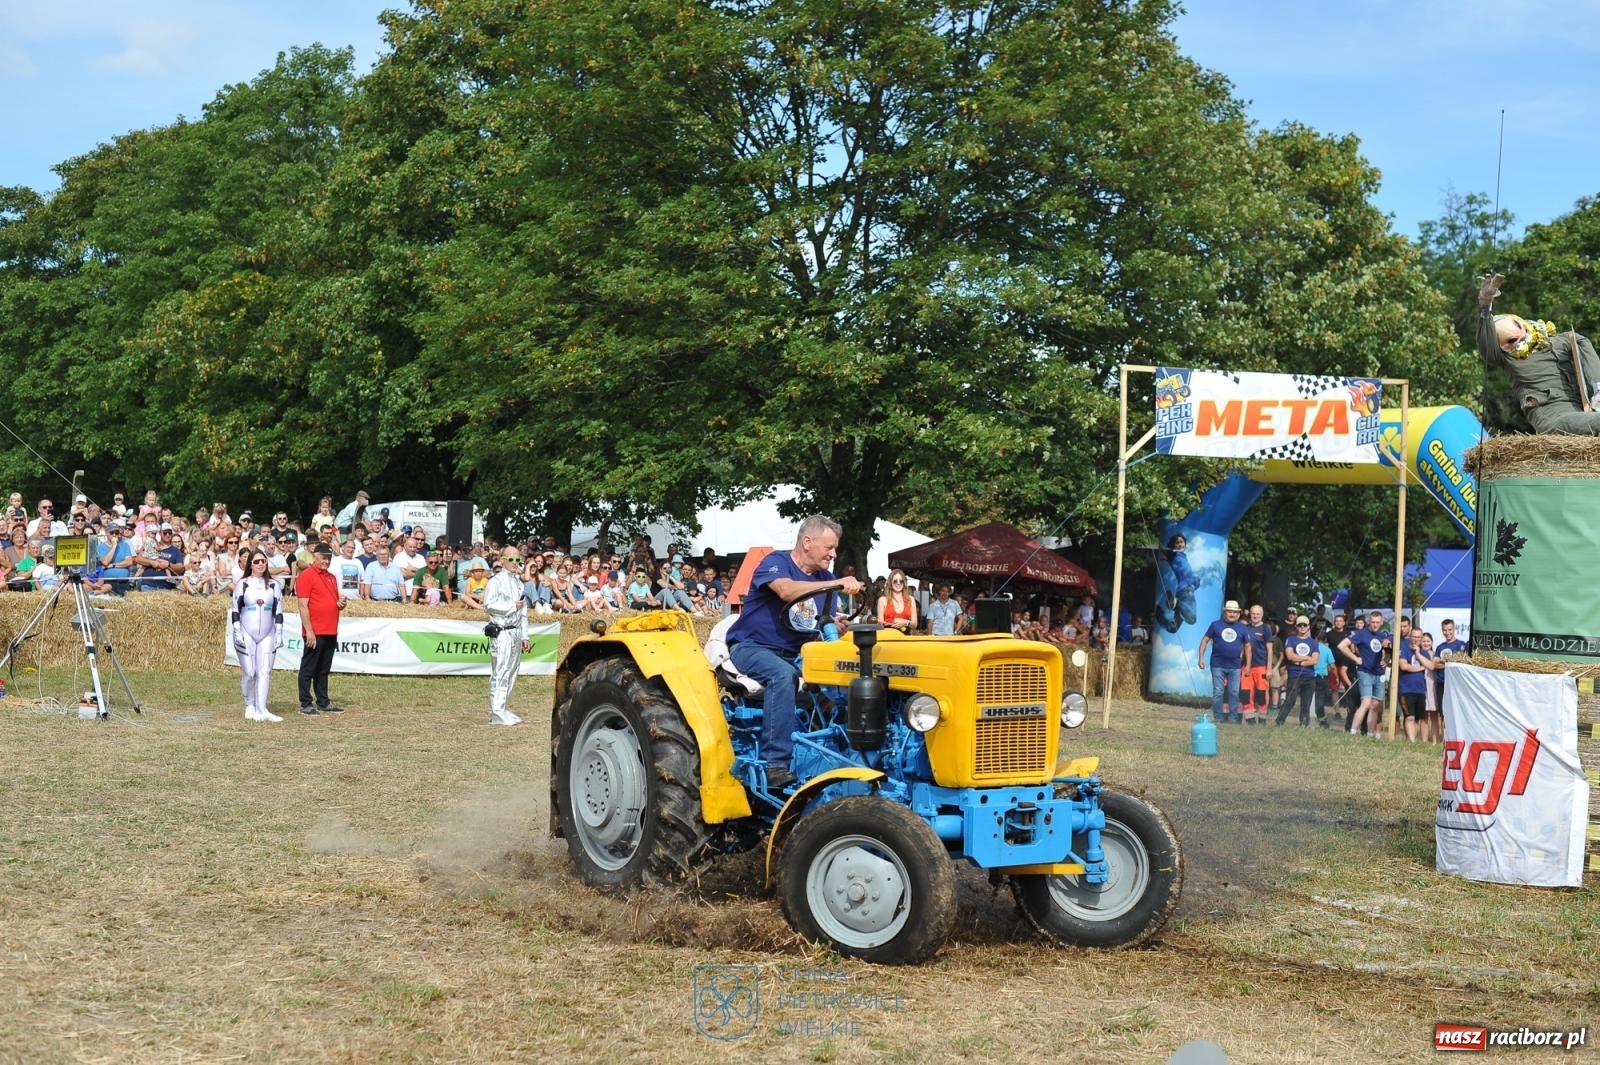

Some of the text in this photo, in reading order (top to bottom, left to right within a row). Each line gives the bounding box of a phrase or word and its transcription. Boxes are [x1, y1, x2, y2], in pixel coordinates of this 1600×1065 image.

[1194, 399, 1350, 436] META
[1428, 439, 1463, 487] Gmina
[1518, 636, 1600, 653] MŁODZIE
[836, 660, 883, 675] URSS
[985, 706, 1042, 717] URSUS
